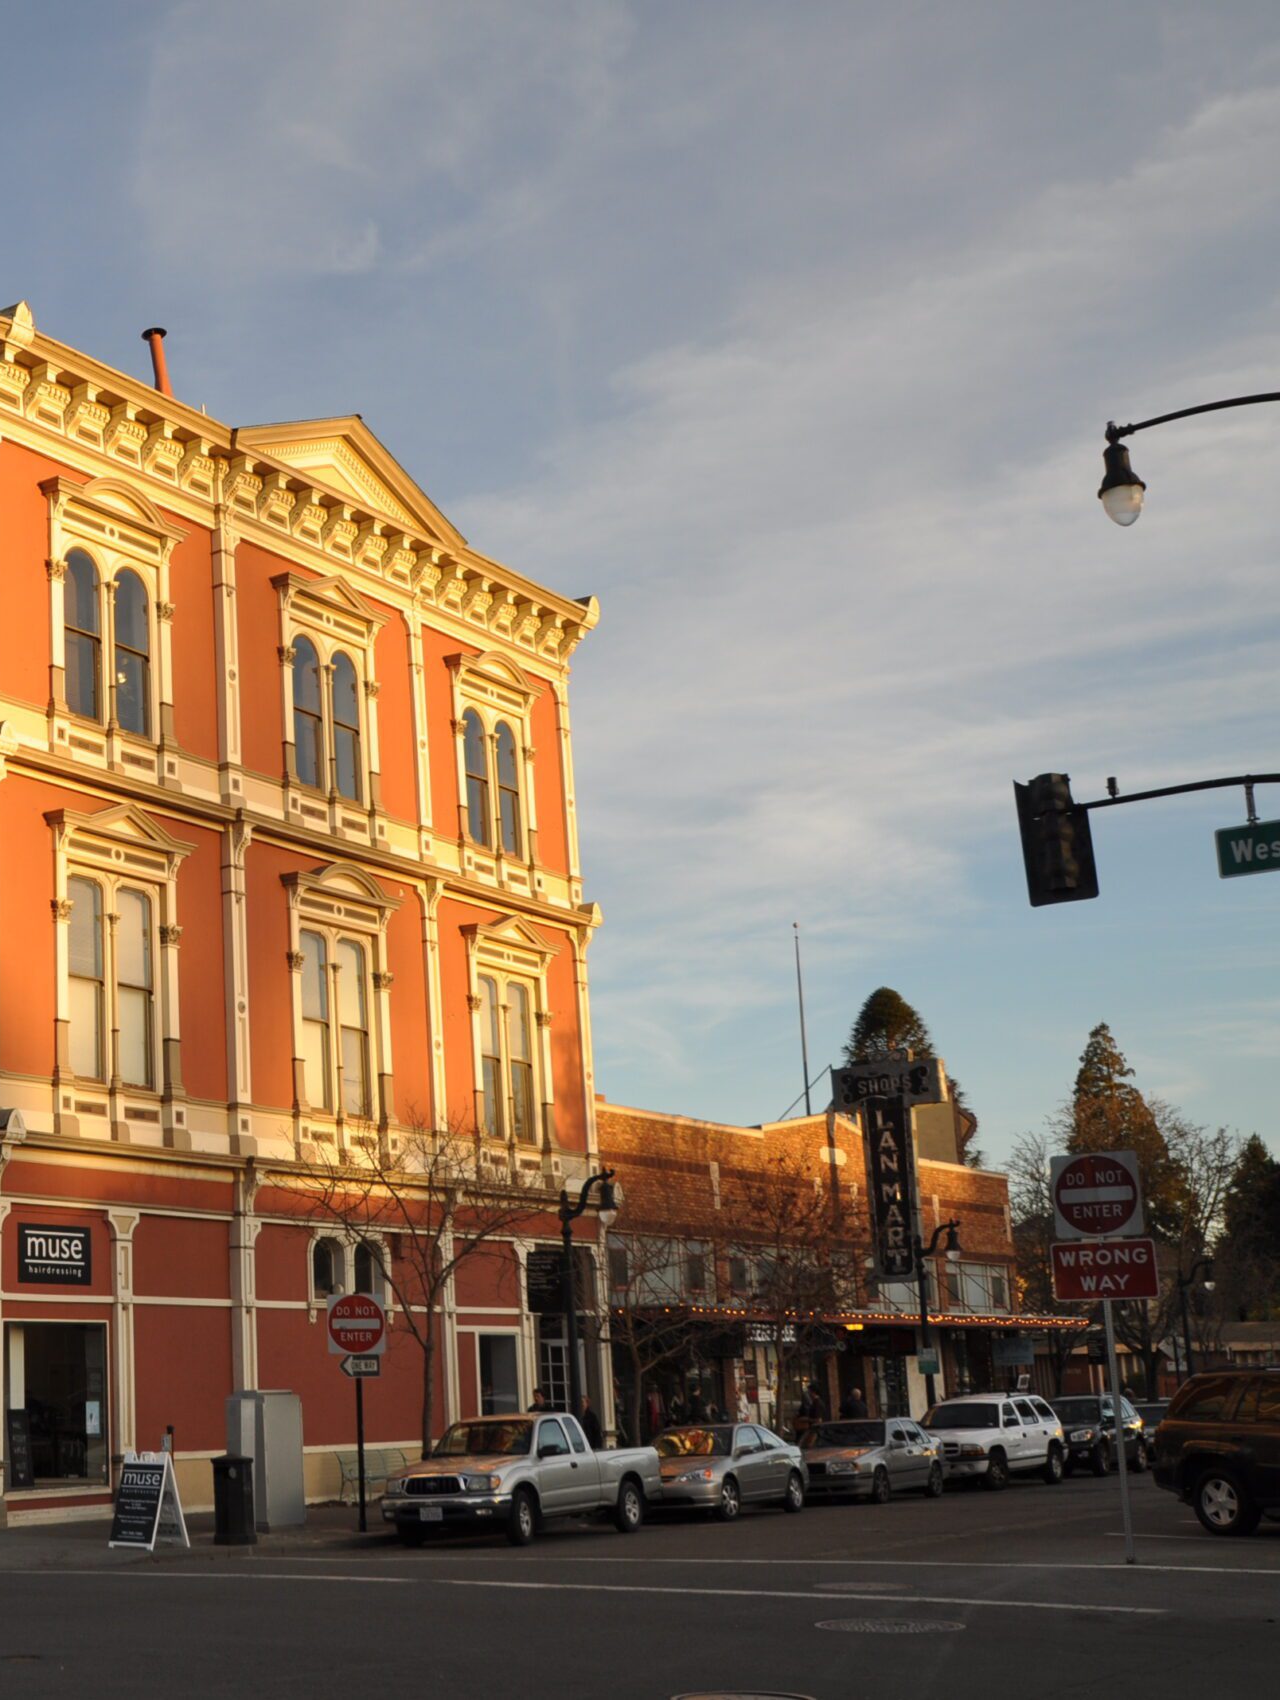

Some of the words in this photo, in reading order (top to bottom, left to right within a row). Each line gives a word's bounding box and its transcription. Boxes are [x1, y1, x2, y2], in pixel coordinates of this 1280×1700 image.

[857, 1076, 911, 1094] SHOPS
[1066, 1173, 1085, 1185] DO
[1095, 1170, 1122, 1184] NOT
[1073, 1204, 1122, 1218] ENTER
[27, 1236, 82, 1259] muse
[1059, 1248, 1148, 1267] WRONG
[28, 1265, 82, 1278] hairdressing
[1080, 1274, 1130, 1292] WAY
[336, 1306, 350, 1316] DO
[355, 1306, 376, 1316] NOT
[340, 1331, 372, 1341] ENTER
[351, 1361, 362, 1370] ONE
[364, 1361, 376, 1370] WAY
[123, 1472, 160, 1486] muse
